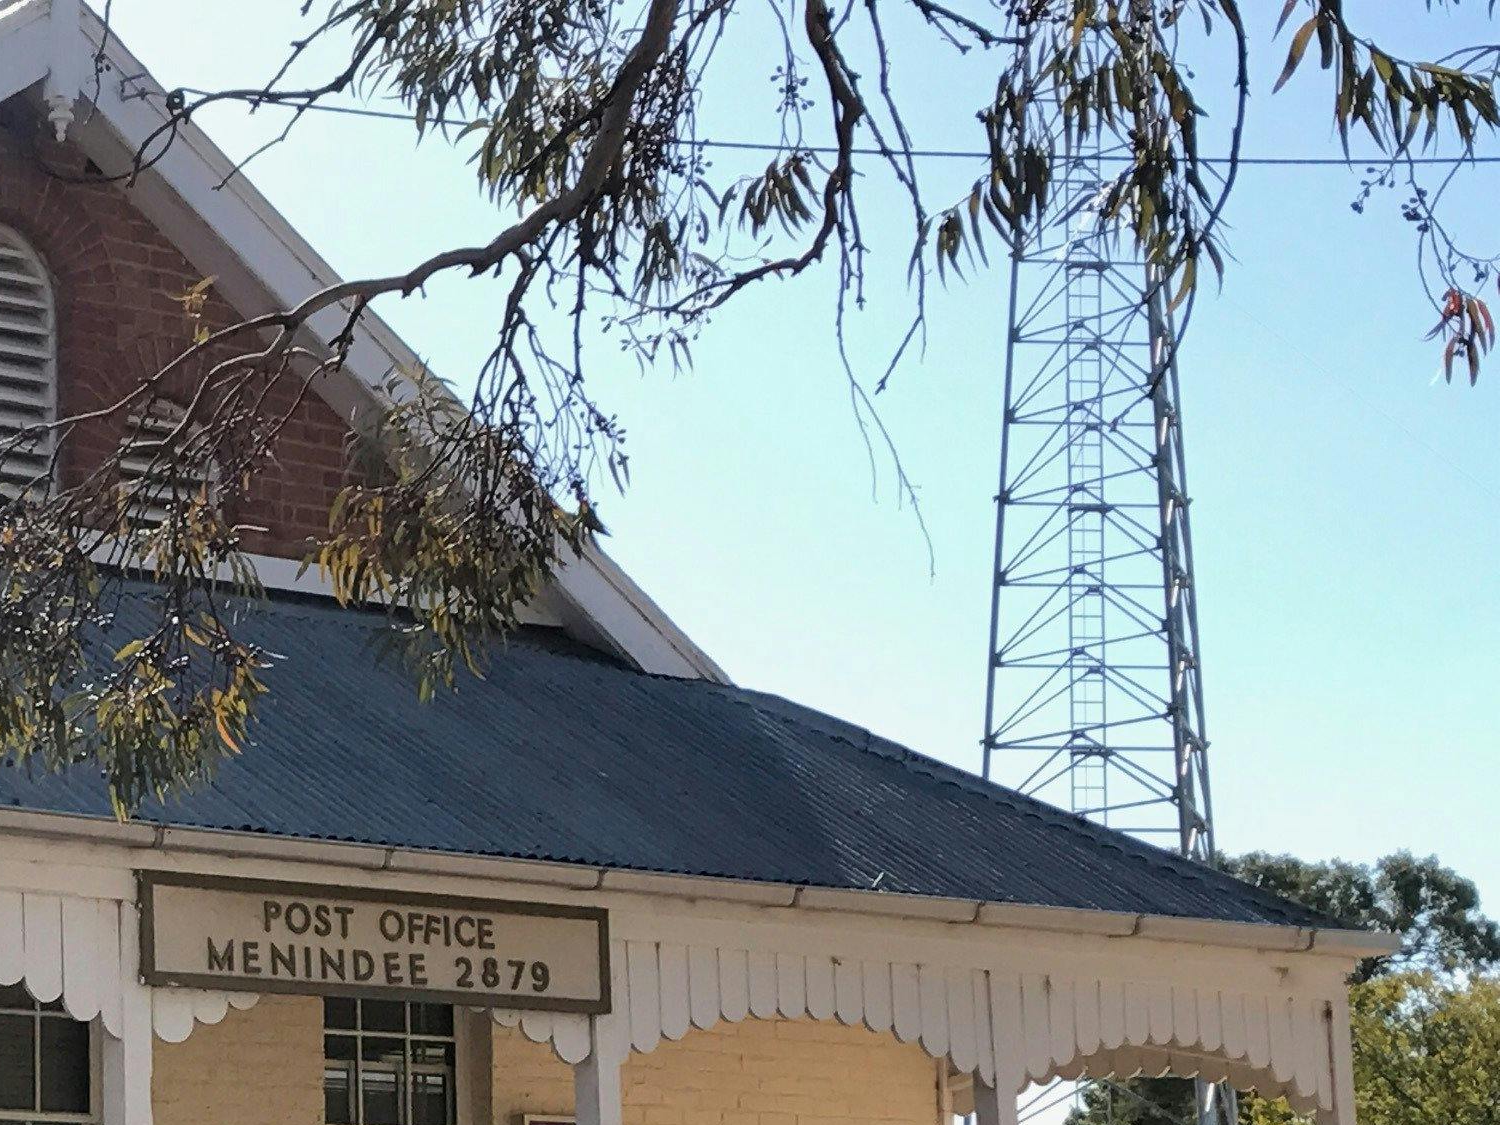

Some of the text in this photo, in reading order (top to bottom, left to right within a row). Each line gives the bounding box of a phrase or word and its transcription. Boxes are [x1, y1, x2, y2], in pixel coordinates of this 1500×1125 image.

[262, 900, 495, 950] POST OFFICE
[206, 937, 551, 992] MENINDEE 2879
